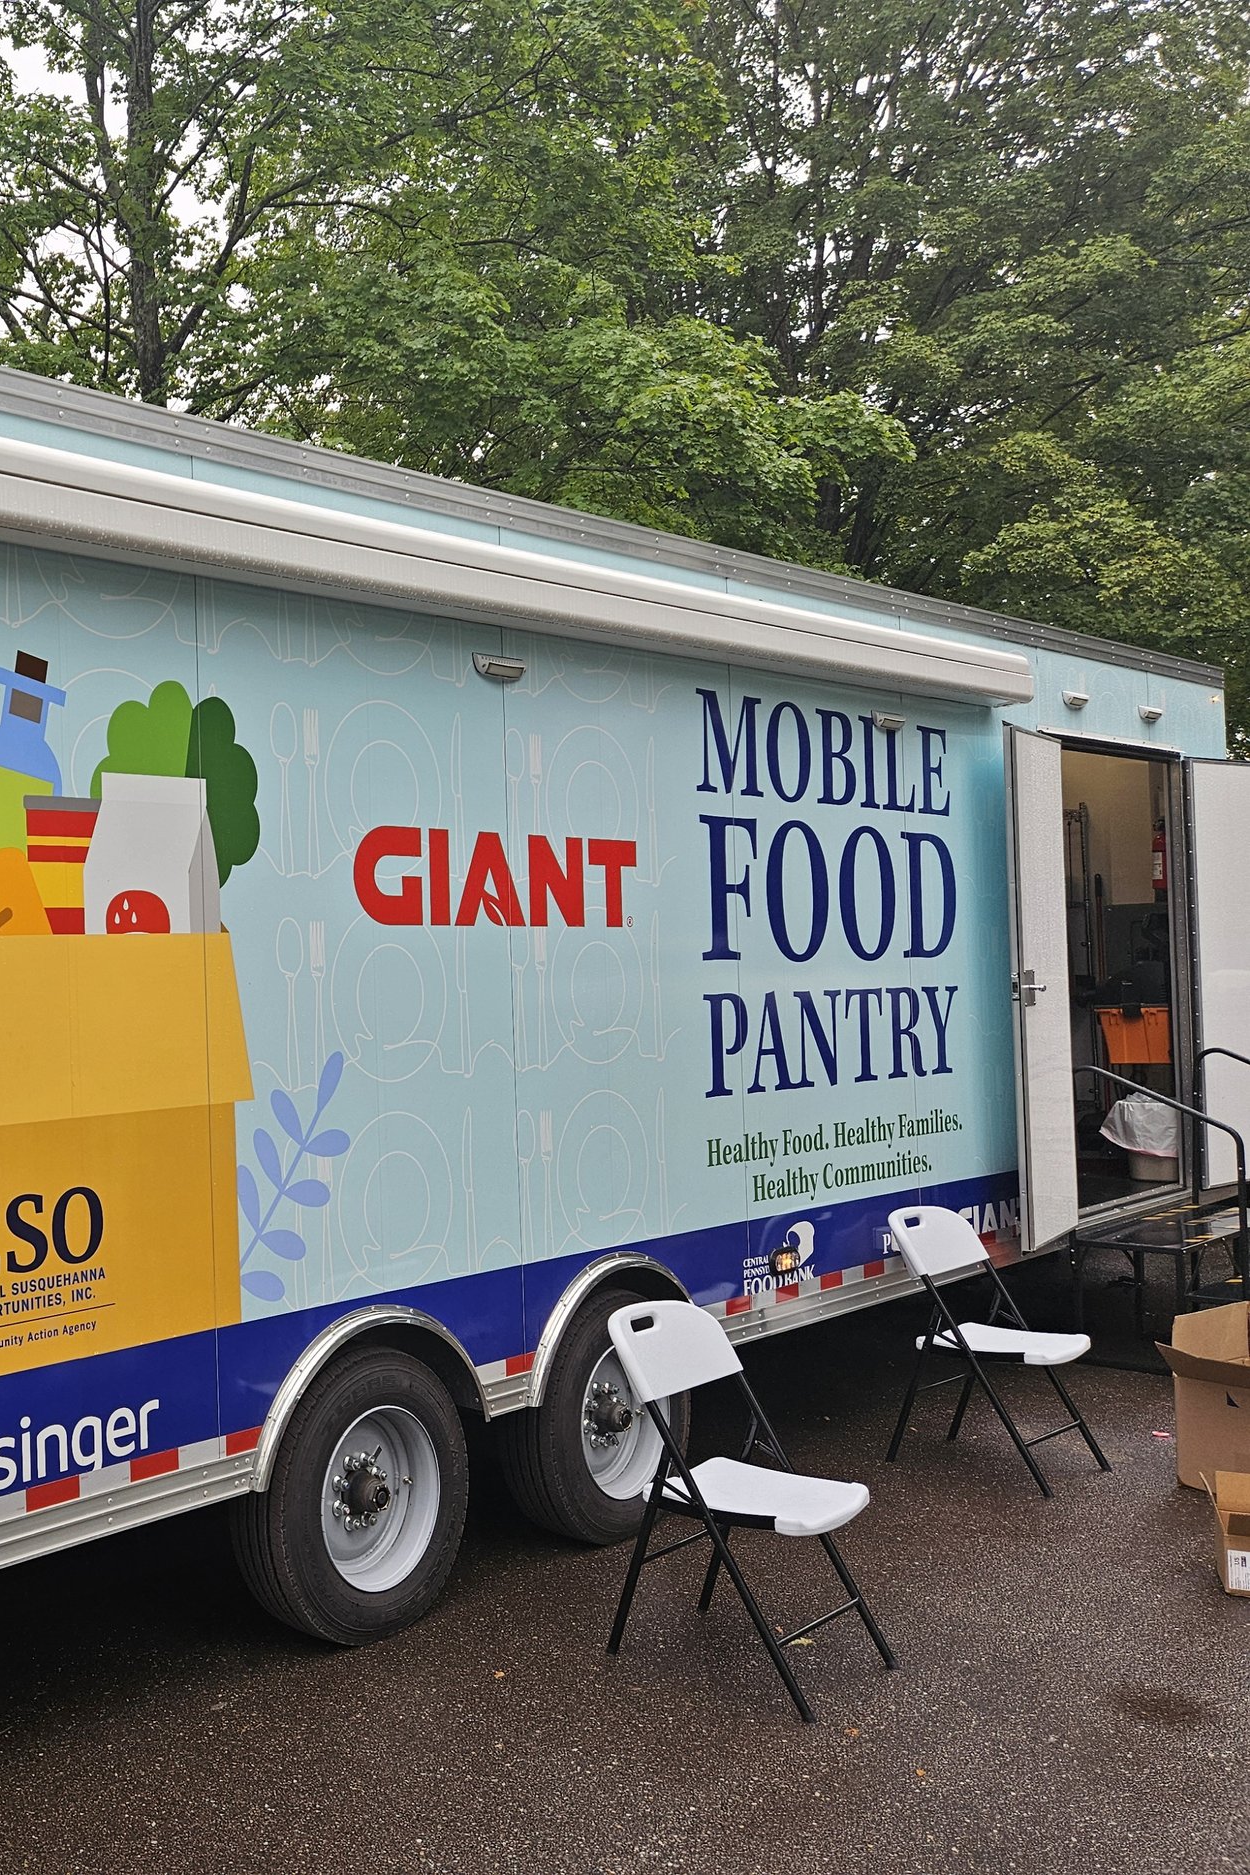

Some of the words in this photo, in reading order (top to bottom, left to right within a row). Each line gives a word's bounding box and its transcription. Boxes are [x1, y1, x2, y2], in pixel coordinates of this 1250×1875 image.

[695, 687, 950, 817] MOBILE
[353, 825, 637, 928] GIANT
[699, 814, 957, 963] FOOD
[703, 985, 958, 1099] PANTRY
[707, 1132, 779, 1167] Healthy
[782, 1124, 830, 1156] Food.
[833, 1117, 896, 1149] Healthy
[898, 1109, 963, 1139] Families.
[752, 1166, 819, 1202] Healthy
[822, 1150, 932, 1190] Communities.
[11, 1267, 106, 1296] SUSQUEHANNA
[71, 1287, 97, 1303] INC.
[743, 1265, 770, 1278] PENNSYL
[743, 1274, 783, 1297] FOOD
[27, 1329, 59, 1342] Action
[62, 1320, 97, 1338] Agency
